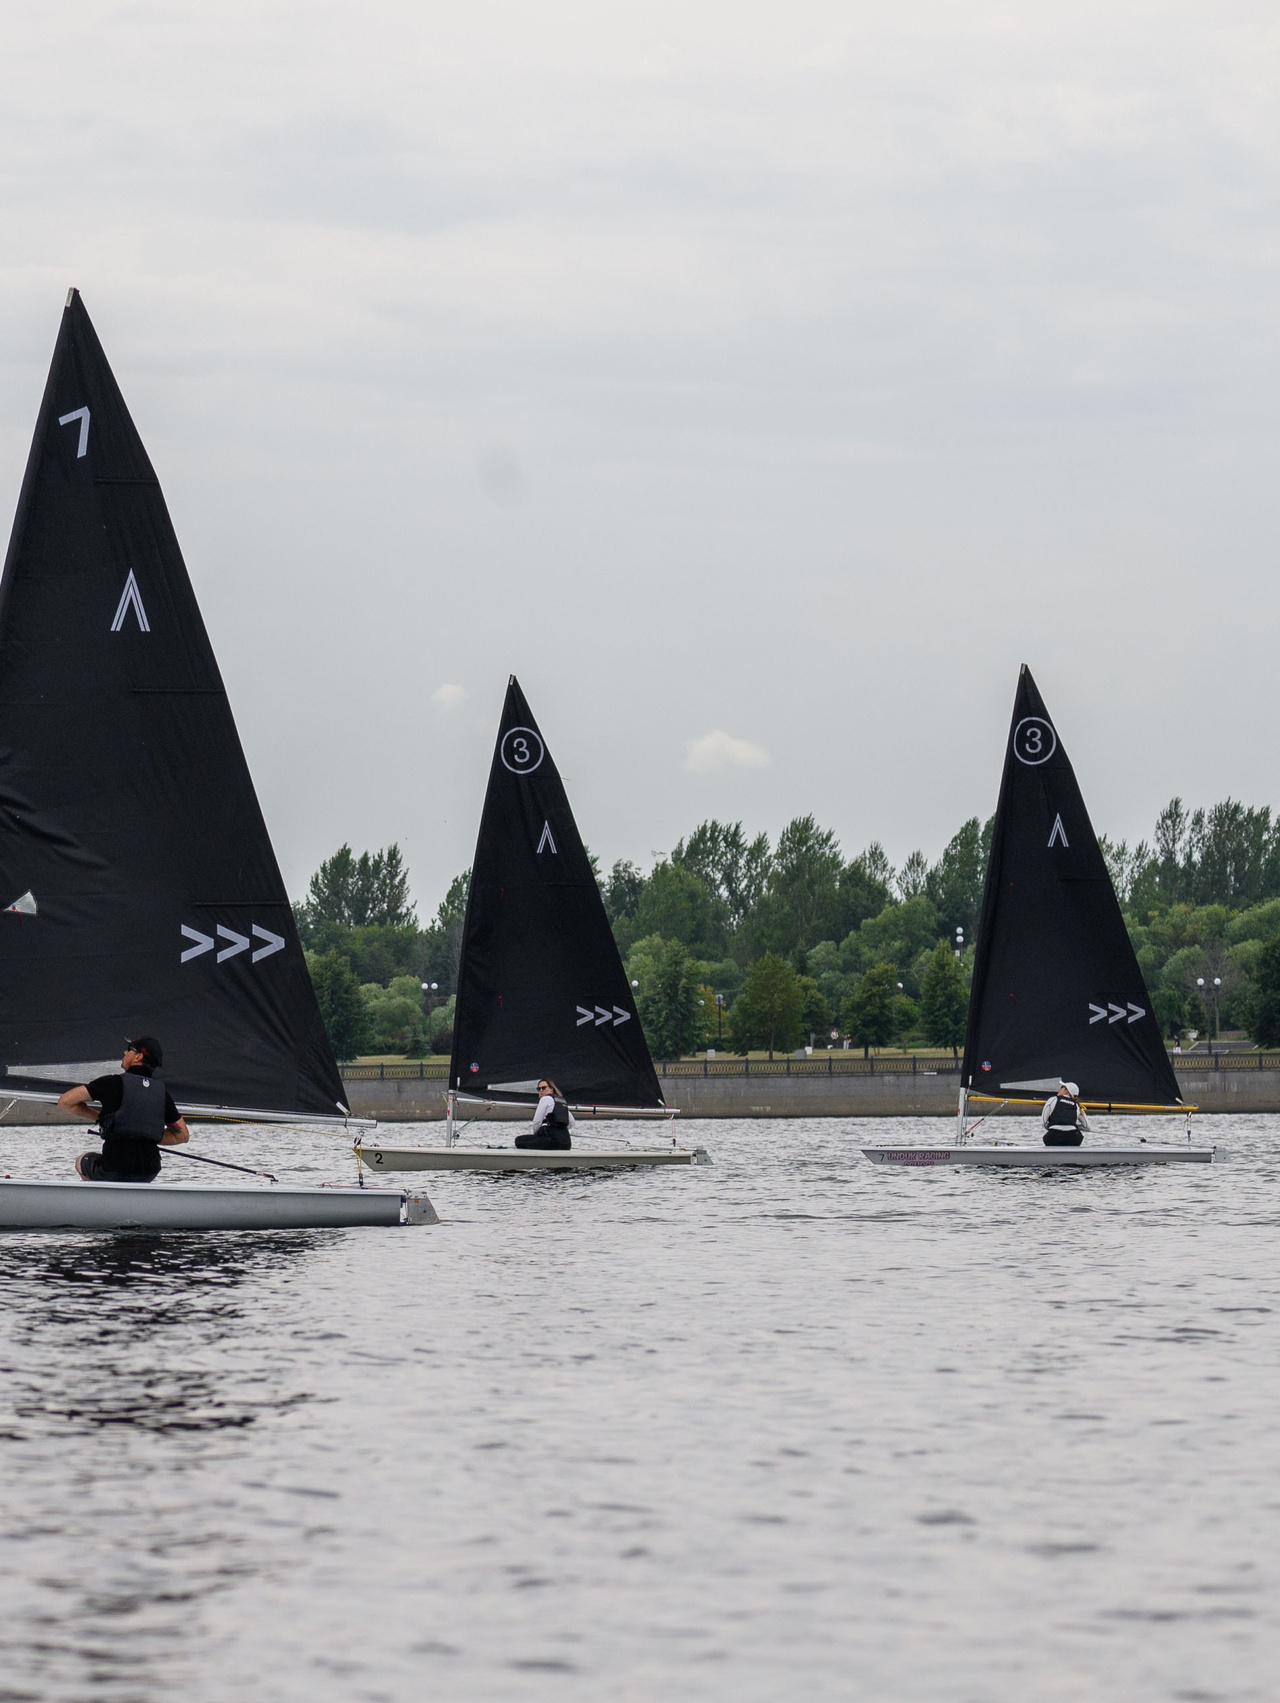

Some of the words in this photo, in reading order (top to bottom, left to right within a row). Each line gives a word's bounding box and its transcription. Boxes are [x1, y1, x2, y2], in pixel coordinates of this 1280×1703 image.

[58, 405, 91, 459] 7
[512, 736, 531, 763] 3
[1025, 726, 1042, 753] 3
[374, 1152, 384, 1165] 2
[878, 1153, 885, 1162] 7
